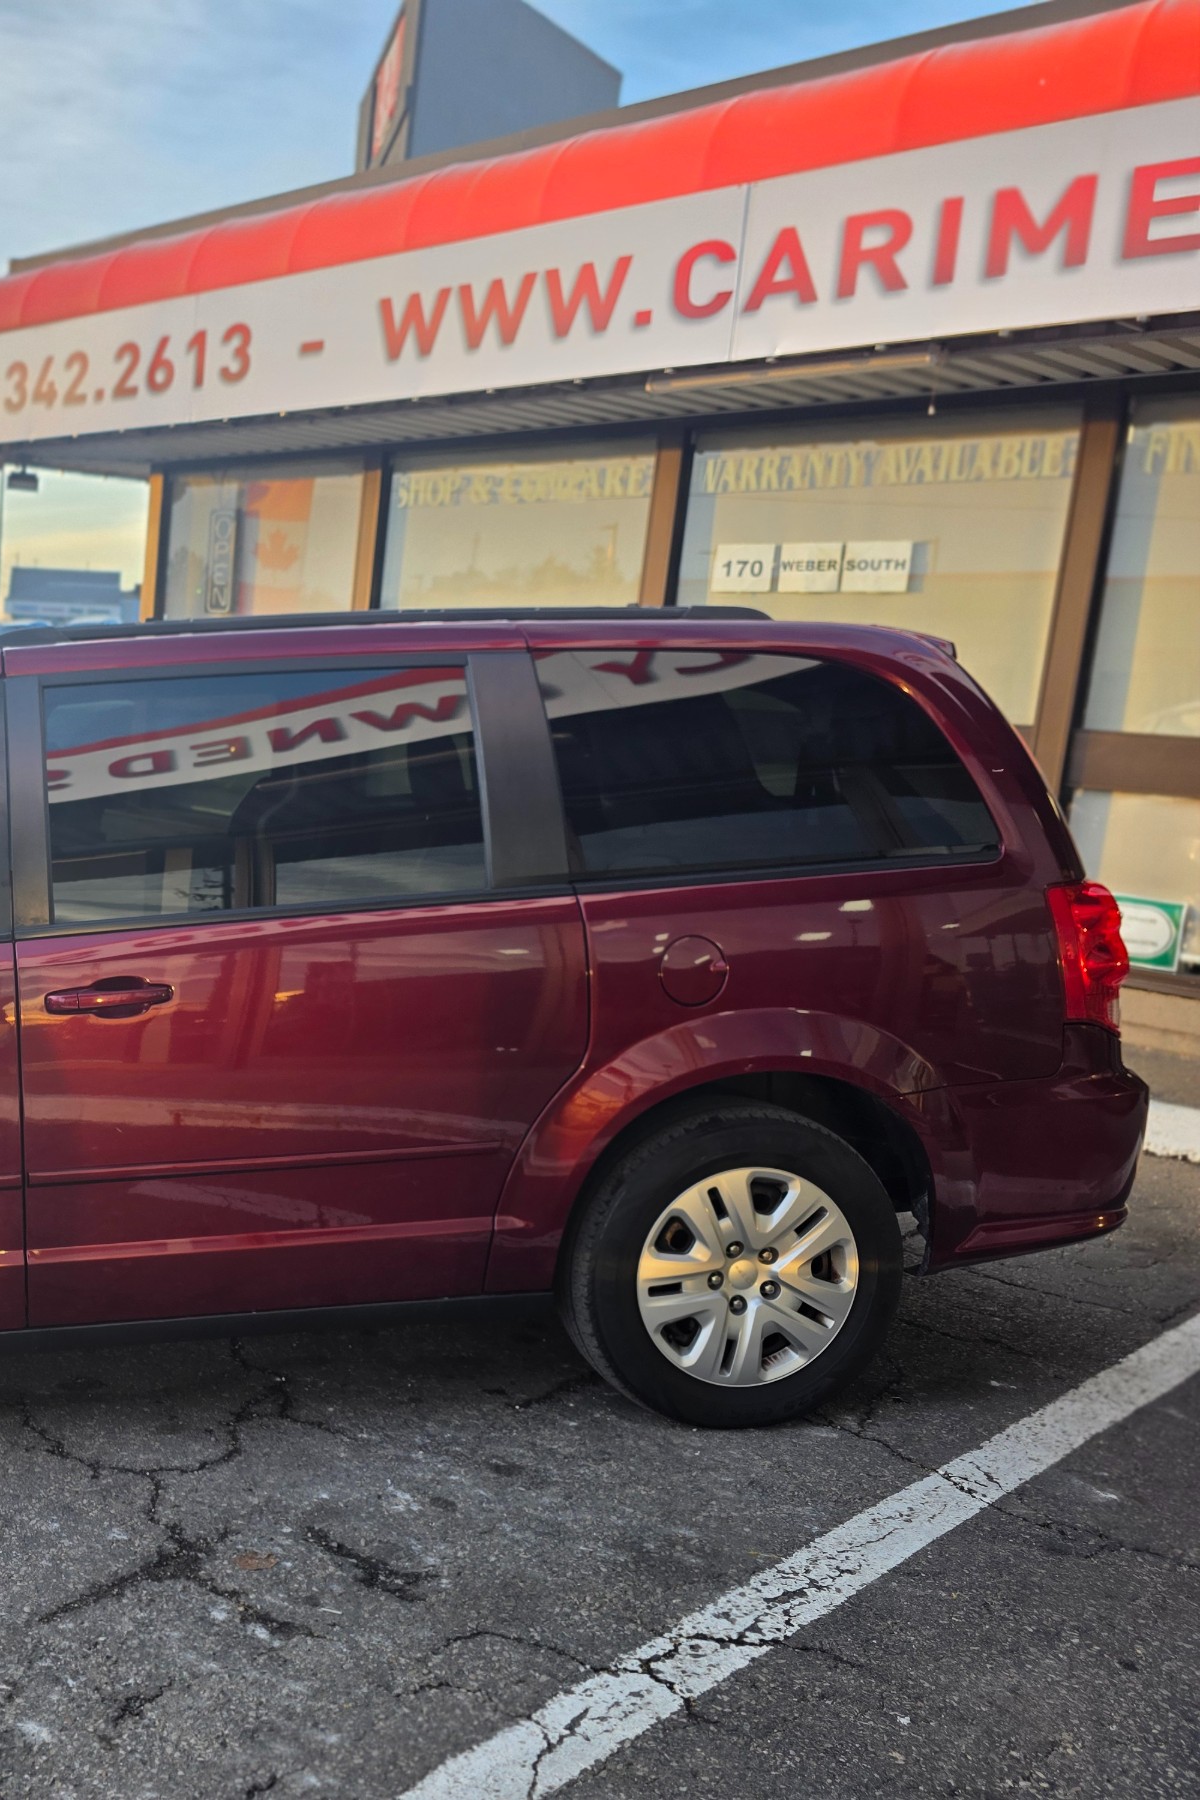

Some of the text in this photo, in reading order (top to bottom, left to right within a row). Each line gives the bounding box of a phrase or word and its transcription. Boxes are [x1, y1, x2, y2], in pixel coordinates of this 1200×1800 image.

[874, 430, 1064, 487] AVAILABLE
[396, 470, 462, 510] SHOP
[721, 558, 908, 577] 170 WEBER SOUTH
